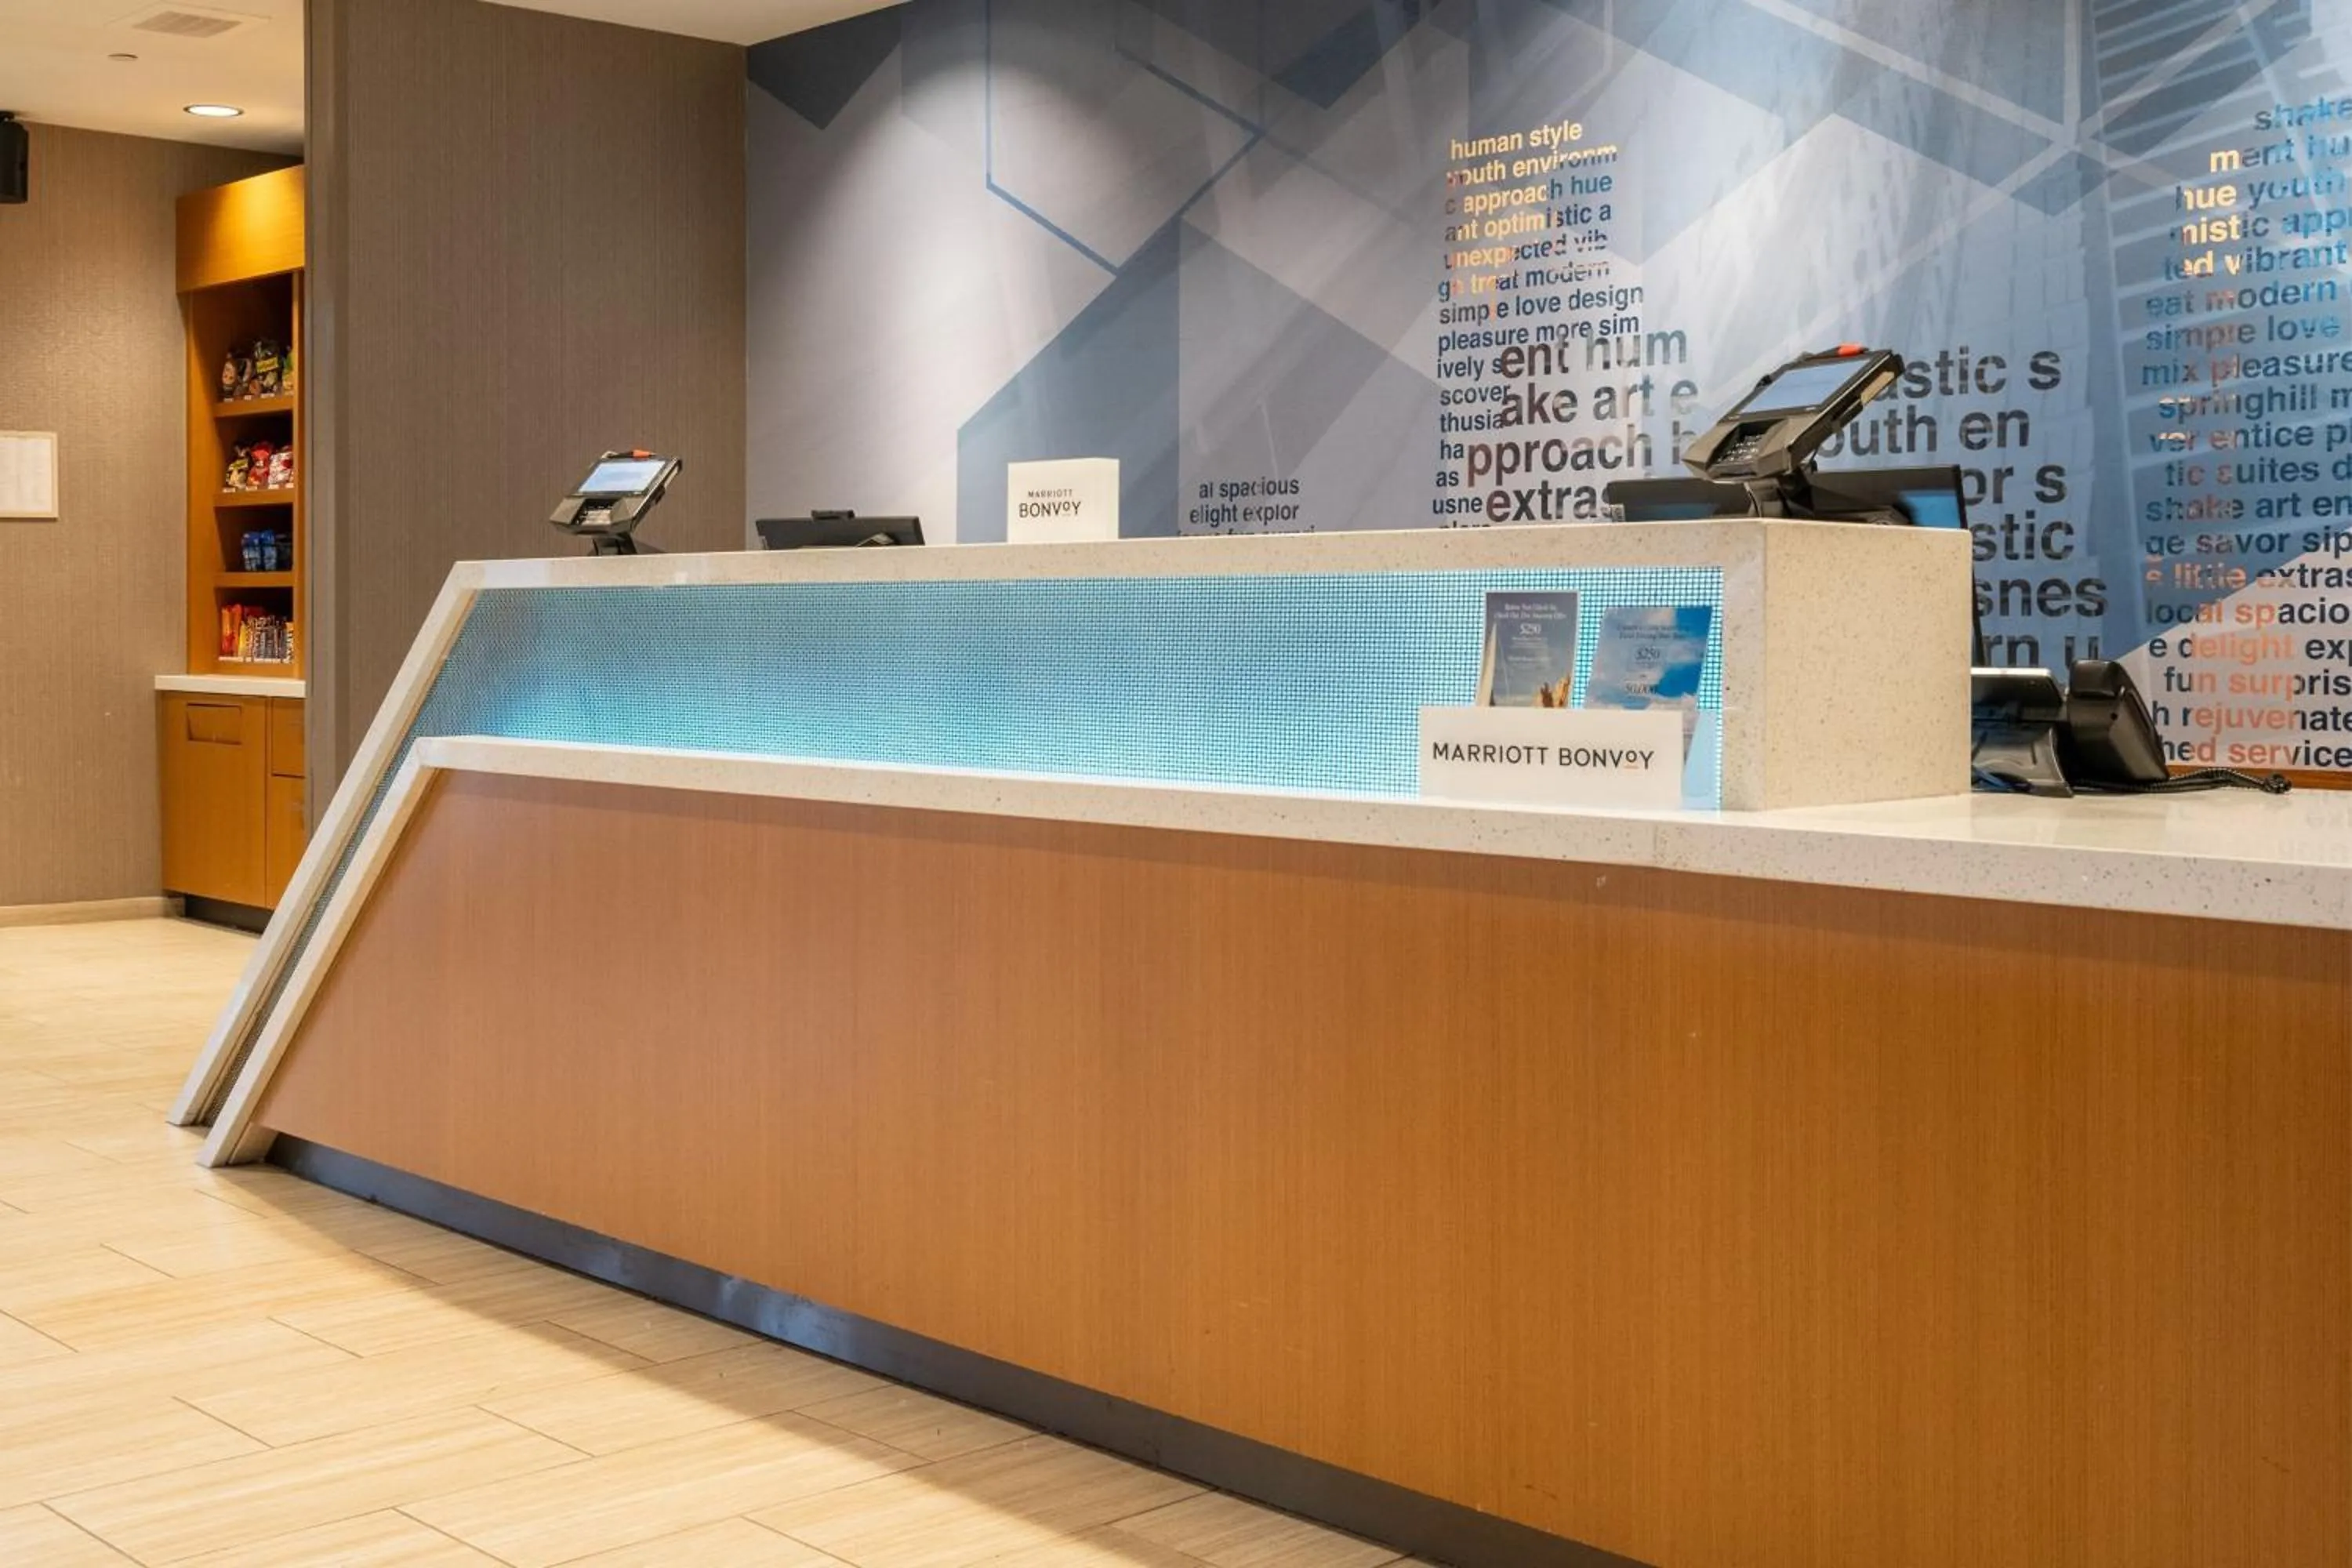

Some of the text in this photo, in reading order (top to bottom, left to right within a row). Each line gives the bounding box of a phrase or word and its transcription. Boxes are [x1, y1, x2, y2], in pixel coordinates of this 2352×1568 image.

[1451, 120, 1582, 161] human style
[1513, 144, 1617, 178] environm
[1464, 179, 1563, 217] approach
[1571, 175, 1613, 197] hue
[1445, 203, 1612, 241] ant optimistic a
[2224, 240, 2347, 275] vibrant
[1526, 261, 1610, 288] modern
[1439, 285, 1643, 328] simple love design
[2205, 279, 2337, 312] modern
[1438, 314, 1639, 355] pleasure more sim
[2146, 315, 2340, 352] simple love
[1501, 328, 1687, 379] ent hum
[2142, 358, 2198, 385] mix
[1440, 383, 1511, 407] scover
[1502, 383, 1578, 427] ake
[1593, 374, 1654, 421] art
[2028, 350, 2061, 390] s
[2158, 383, 2317, 426] springhill
[1440, 409, 1504, 433] thusia
[2209, 422, 2314, 450] entice
[1440, 439, 1465, 460] ha
[1468, 423, 1653, 488] pproach
[1959, 408, 2030, 451] en
[1436, 470, 1458, 487] as
[2035, 464, 2067, 504] s
[2216, 456, 2320, 485] suites
[1028, 488, 1073, 498] MARRIOTT
[1219, 477, 1299, 502] spacious
[1432, 496, 1483, 514] usne
[2256, 492, 2301, 518] art
[2312, 495, 2352, 517] en
[1018, 501, 1081, 517] BONVOY
[1190, 504, 1300, 528] elight explor
[2196, 531, 2288, 555] savor
[2147, 597, 2350, 630] local spacio
[2149, 633, 2352, 667] e delight ex
[2164, 666, 2352, 702] fun surpris
[1432, 742, 1655, 770] MARRIOTT BONVOY
[2228, 739, 2352, 768] service
